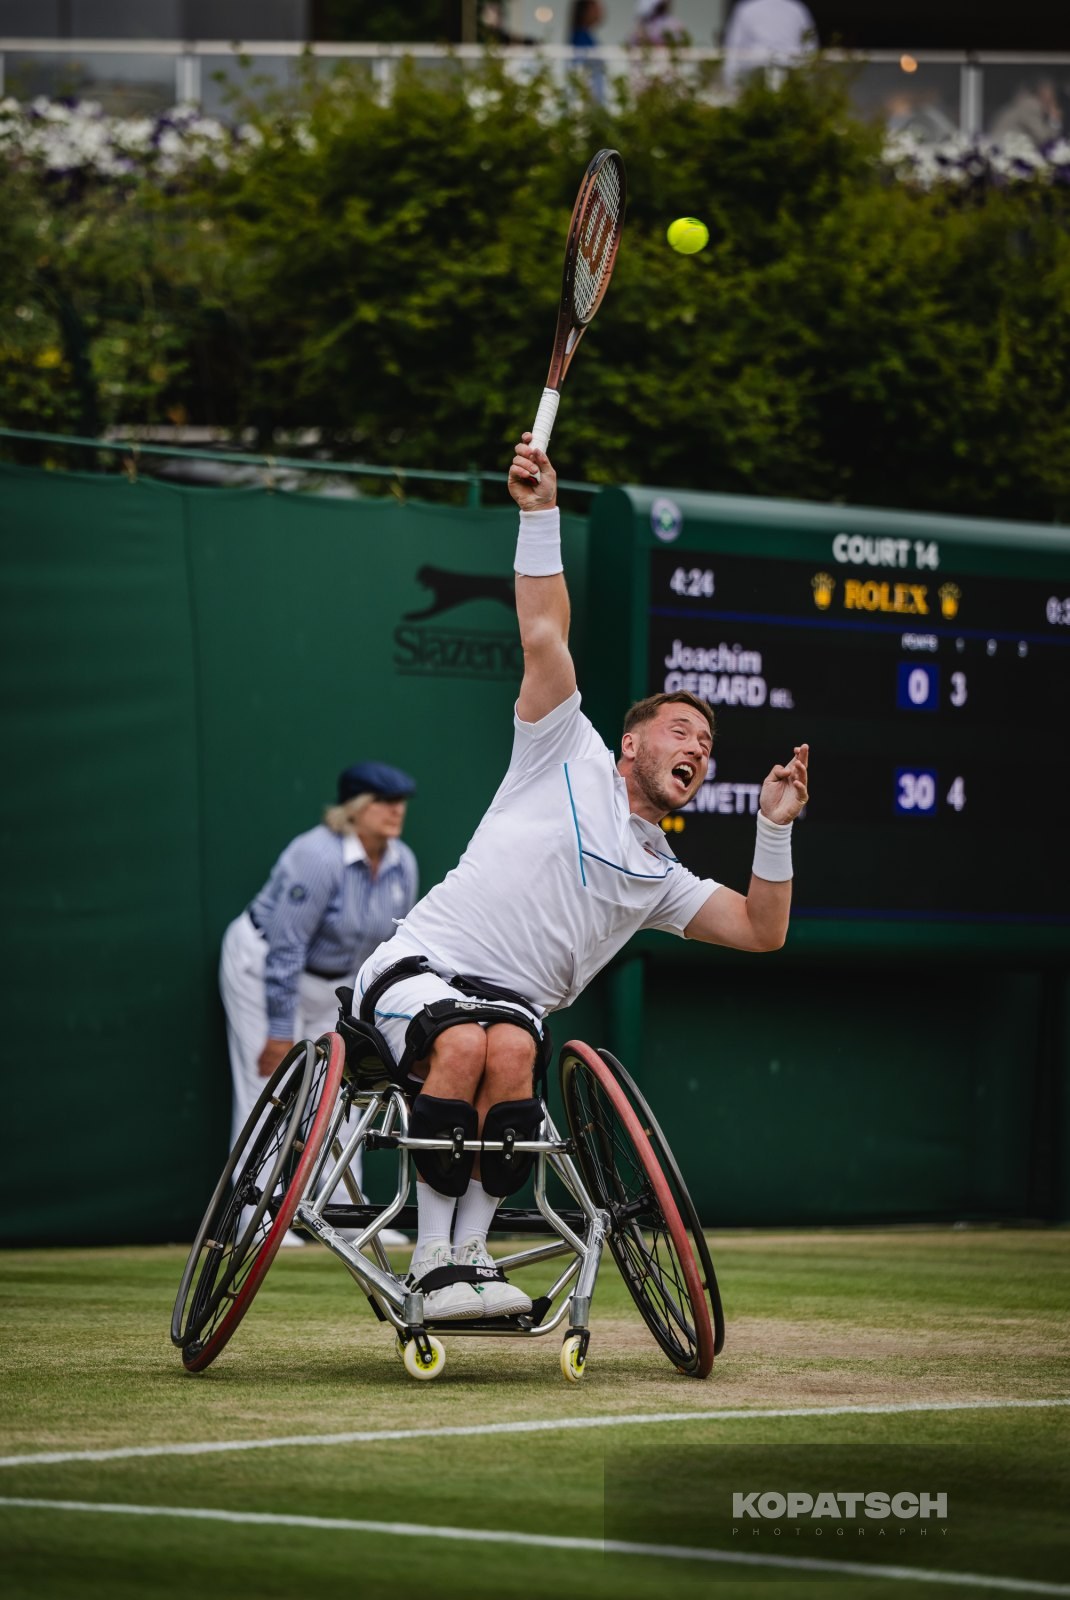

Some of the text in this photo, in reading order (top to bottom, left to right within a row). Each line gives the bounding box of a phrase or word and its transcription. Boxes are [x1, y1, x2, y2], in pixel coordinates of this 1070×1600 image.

[833, 534, 939, 570] COURT 14
[670, 567, 715, 597] 4:24
[844, 580, 929, 615] ROLEX
[665, 639, 762, 674] Joachim
[664, 671, 767, 707] GERARD
[908, 669, 929, 704] 0
[951, 672, 967, 707] 3
[898, 773, 935, 810] 30
[947, 776, 966, 811] 4
